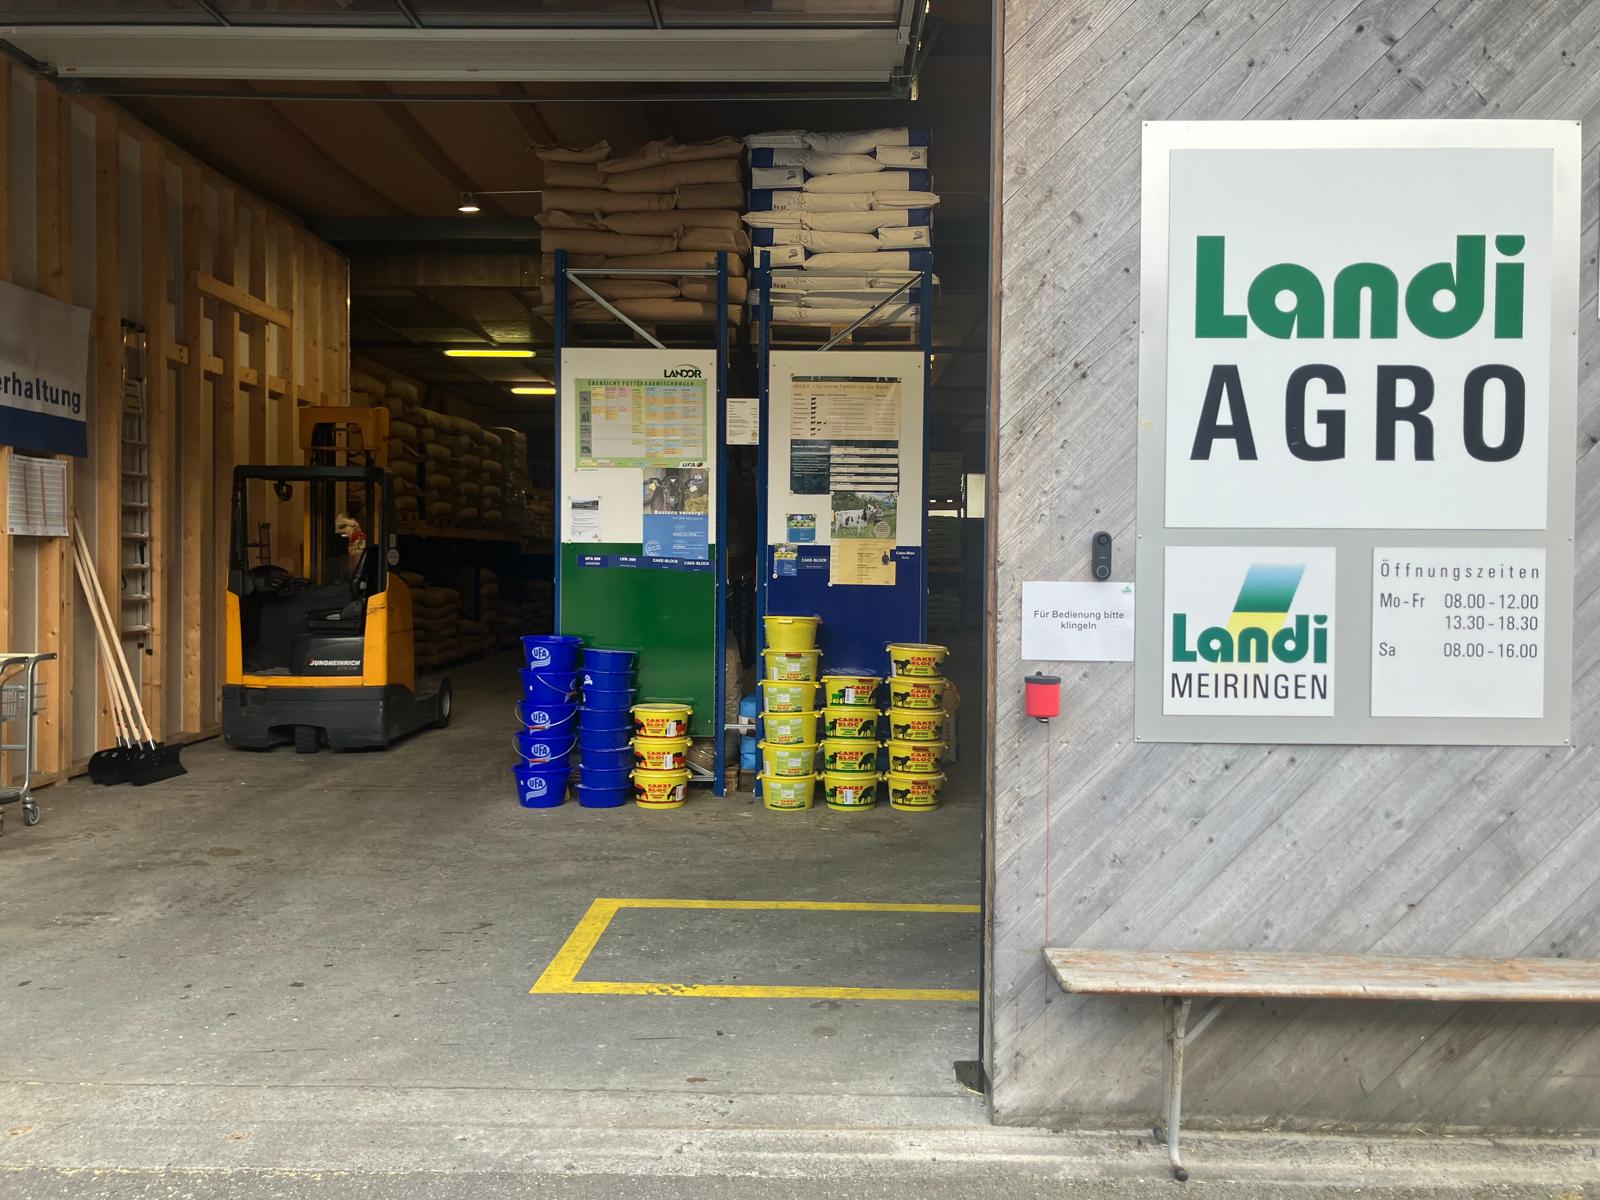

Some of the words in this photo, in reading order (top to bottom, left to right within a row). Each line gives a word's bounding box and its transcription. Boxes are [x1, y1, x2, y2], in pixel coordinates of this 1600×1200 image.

[1195, 235, 1525, 339] Landi
[664, 369, 702, 378] LANDOR
[0, 371, 81, 414] rhaltung
[1190, 364, 1526, 462] AGRO
[1380, 559, 1539, 581] Öffnungszeiten
[1033, 609, 1050, 620] Für
[1052, 609, 1101, 621] Bedienung
[1104, 610, 1125, 620] bitte
[1060, 620, 1097, 631] klingeln
[1172, 613, 1328, 664] Landi
[532, 647, 548, 659] UFA
[1379, 642, 1396, 657] Sa
[1171, 672, 1328, 700] MEIRINGEN
[532, 712, 547, 723] UFA
[532, 745, 548, 756] UFA
[528, 778, 544, 789] UFA
